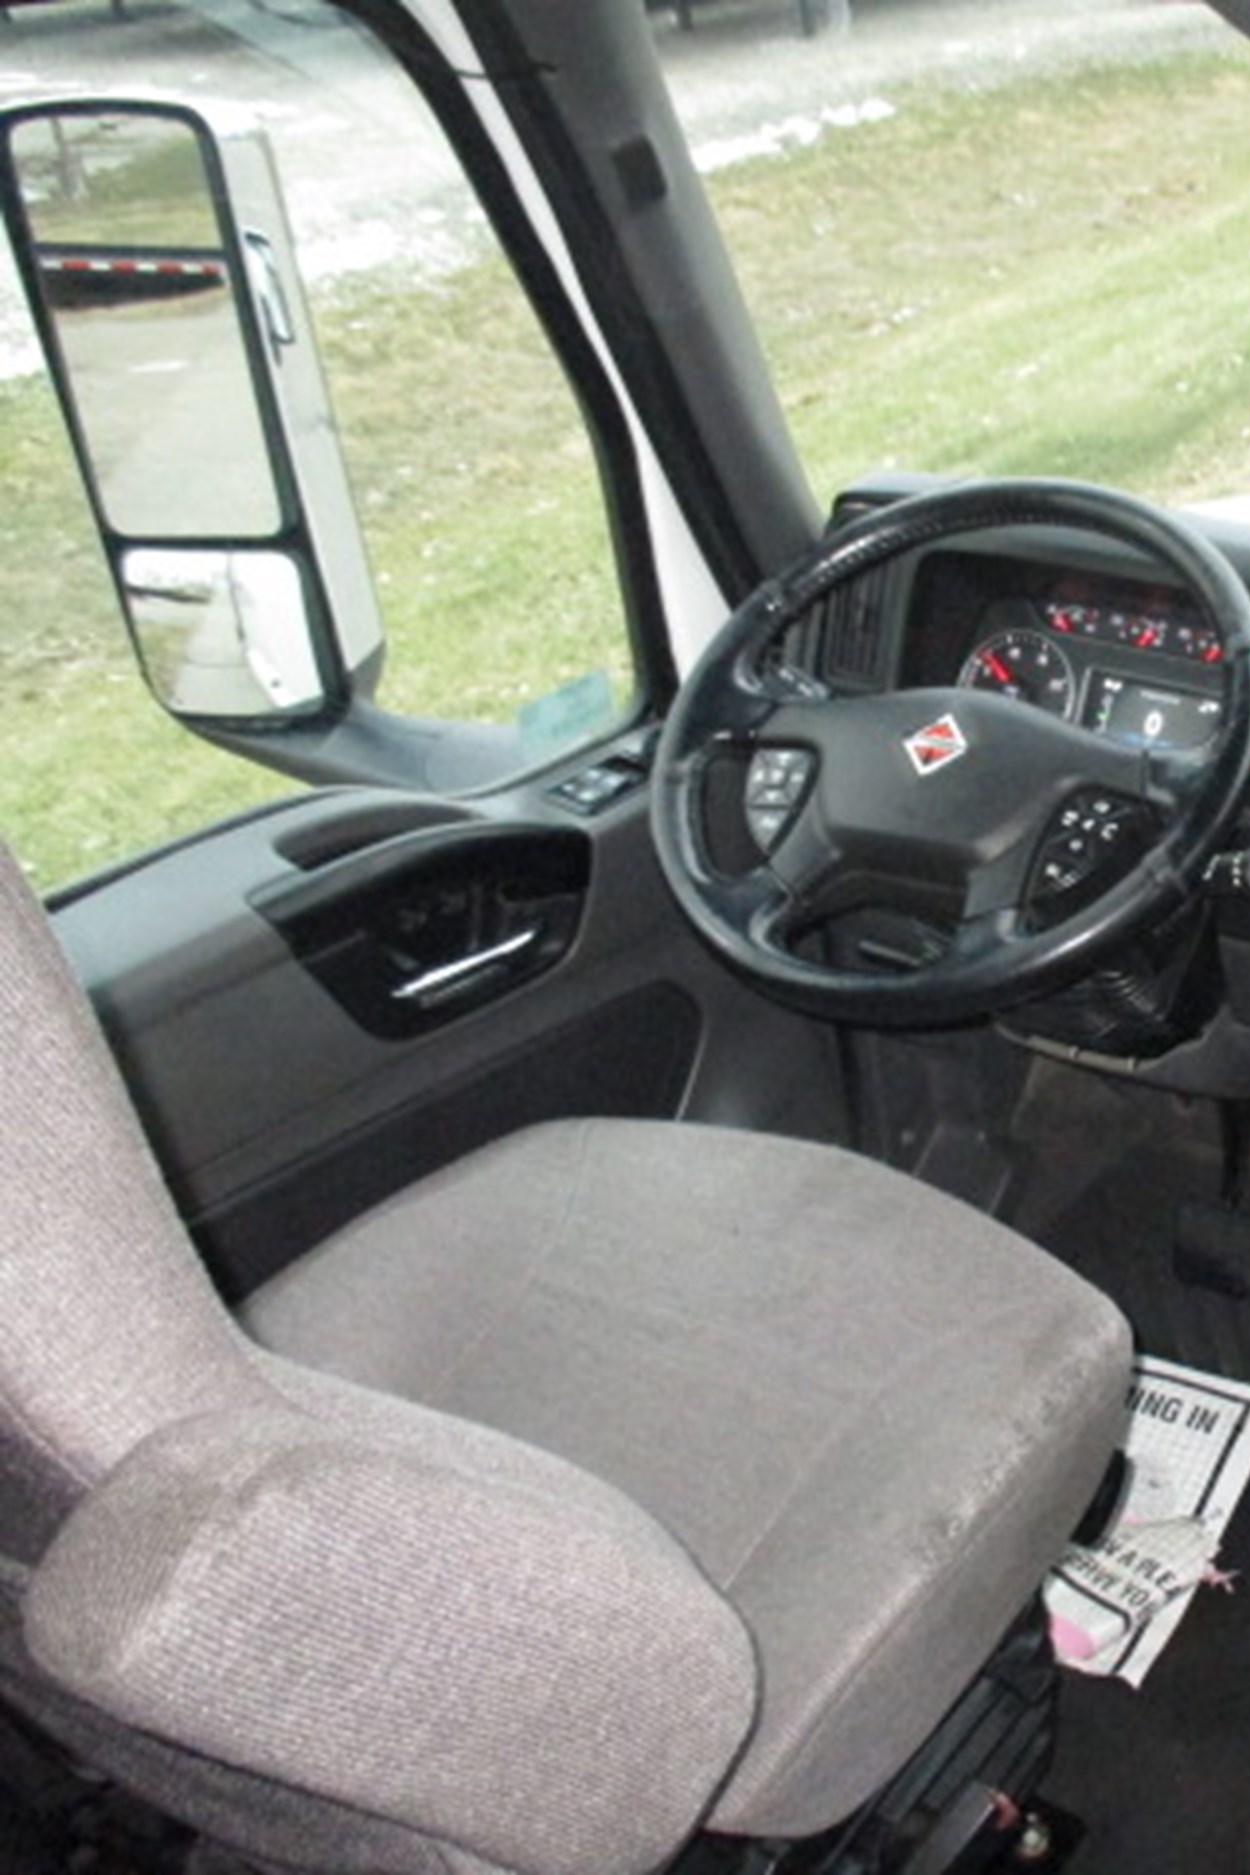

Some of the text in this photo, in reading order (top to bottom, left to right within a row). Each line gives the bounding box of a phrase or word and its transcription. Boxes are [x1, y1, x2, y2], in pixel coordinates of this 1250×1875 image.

[1144, 711, 1163, 736] 0
[1124, 1386, 1220, 1434] ING IN
